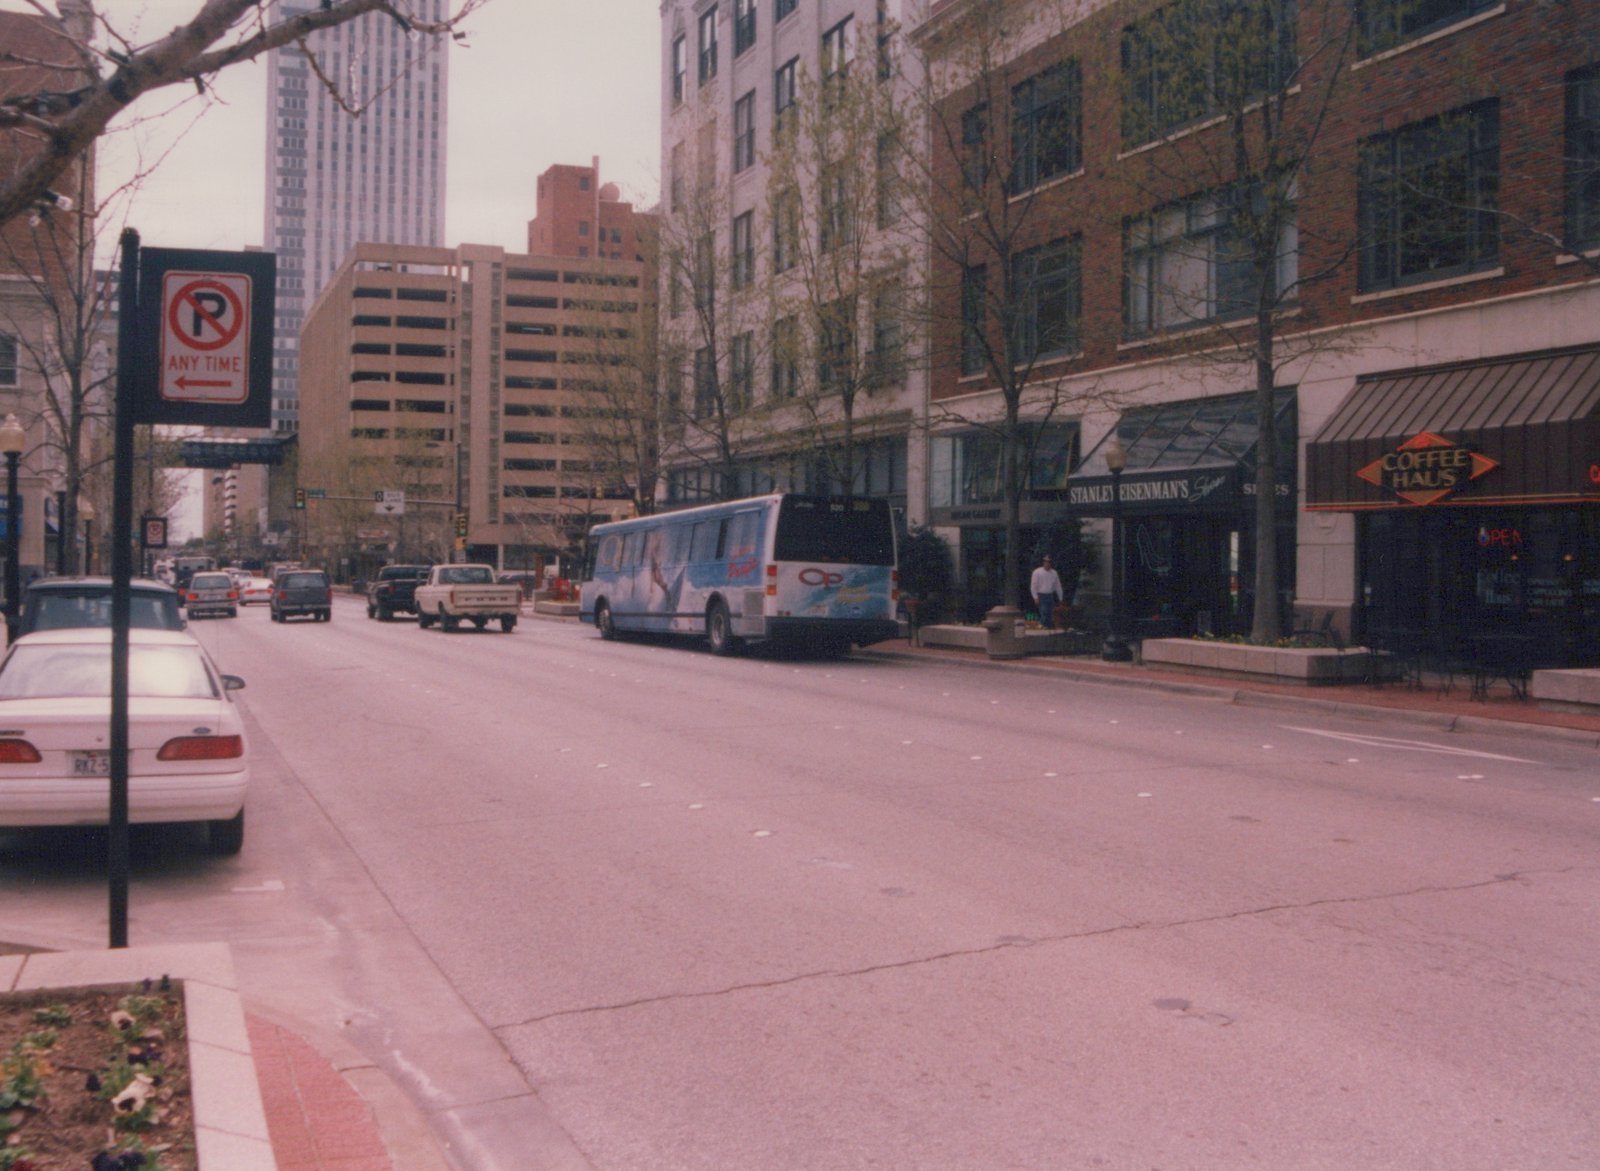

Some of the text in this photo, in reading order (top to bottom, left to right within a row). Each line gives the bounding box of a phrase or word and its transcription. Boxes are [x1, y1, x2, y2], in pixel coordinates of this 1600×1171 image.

[168, 355, 241, 372] ANY TIME
[1382, 448, 1469, 471] COFFEE
[1392, 468, 1457, 488] HAUS
[1119, 480, 1189, 501] EISENMAN'S
[1477, 527, 1522, 547] OPEN
